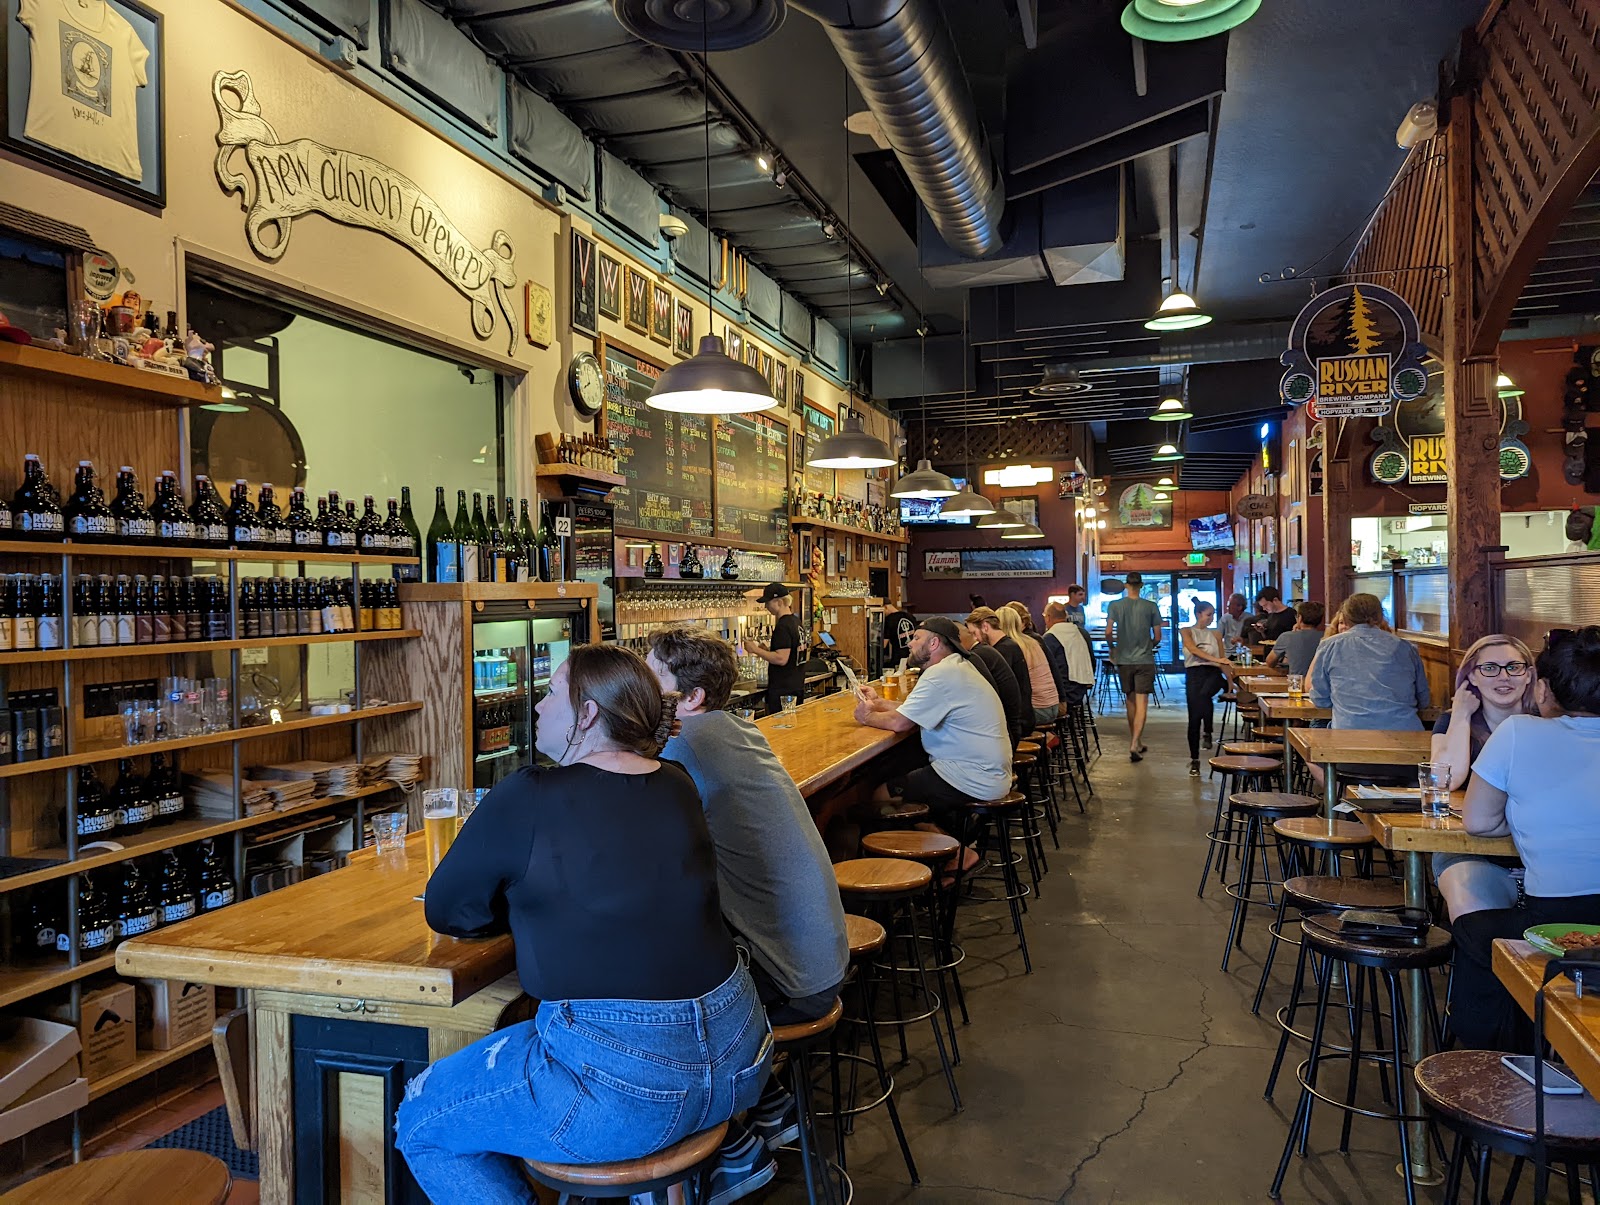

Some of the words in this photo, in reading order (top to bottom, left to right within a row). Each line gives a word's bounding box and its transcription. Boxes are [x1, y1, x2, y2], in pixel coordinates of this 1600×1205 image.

[257, 149, 313, 204] new
[321, 152, 403, 224] albion
[410, 193, 492, 290] brewery
[1320, 357, 1388, 383] RUSSIAN
[1320, 380, 1388, 396] RIVER
[1320, 395, 1352, 403] BREWING
[1353, 393, 1389, 401] COMPANY
[1413, 461, 1447, 474] RIV
[1411, 474, 1447, 482] BREWING
[1411, 504, 1447, 512] HOPYARD
[33, 513, 64, 523] RUSSIA
[87, 516, 116, 526] RUSSIA
[129, 519, 156, 529] RUSSIA
[558, 520, 569, 533] 22
[1395, 520, 1406, 530] EXI
[927, 554, 960, 565] Hamm's
[80, 927, 105, 942] SSIAN
